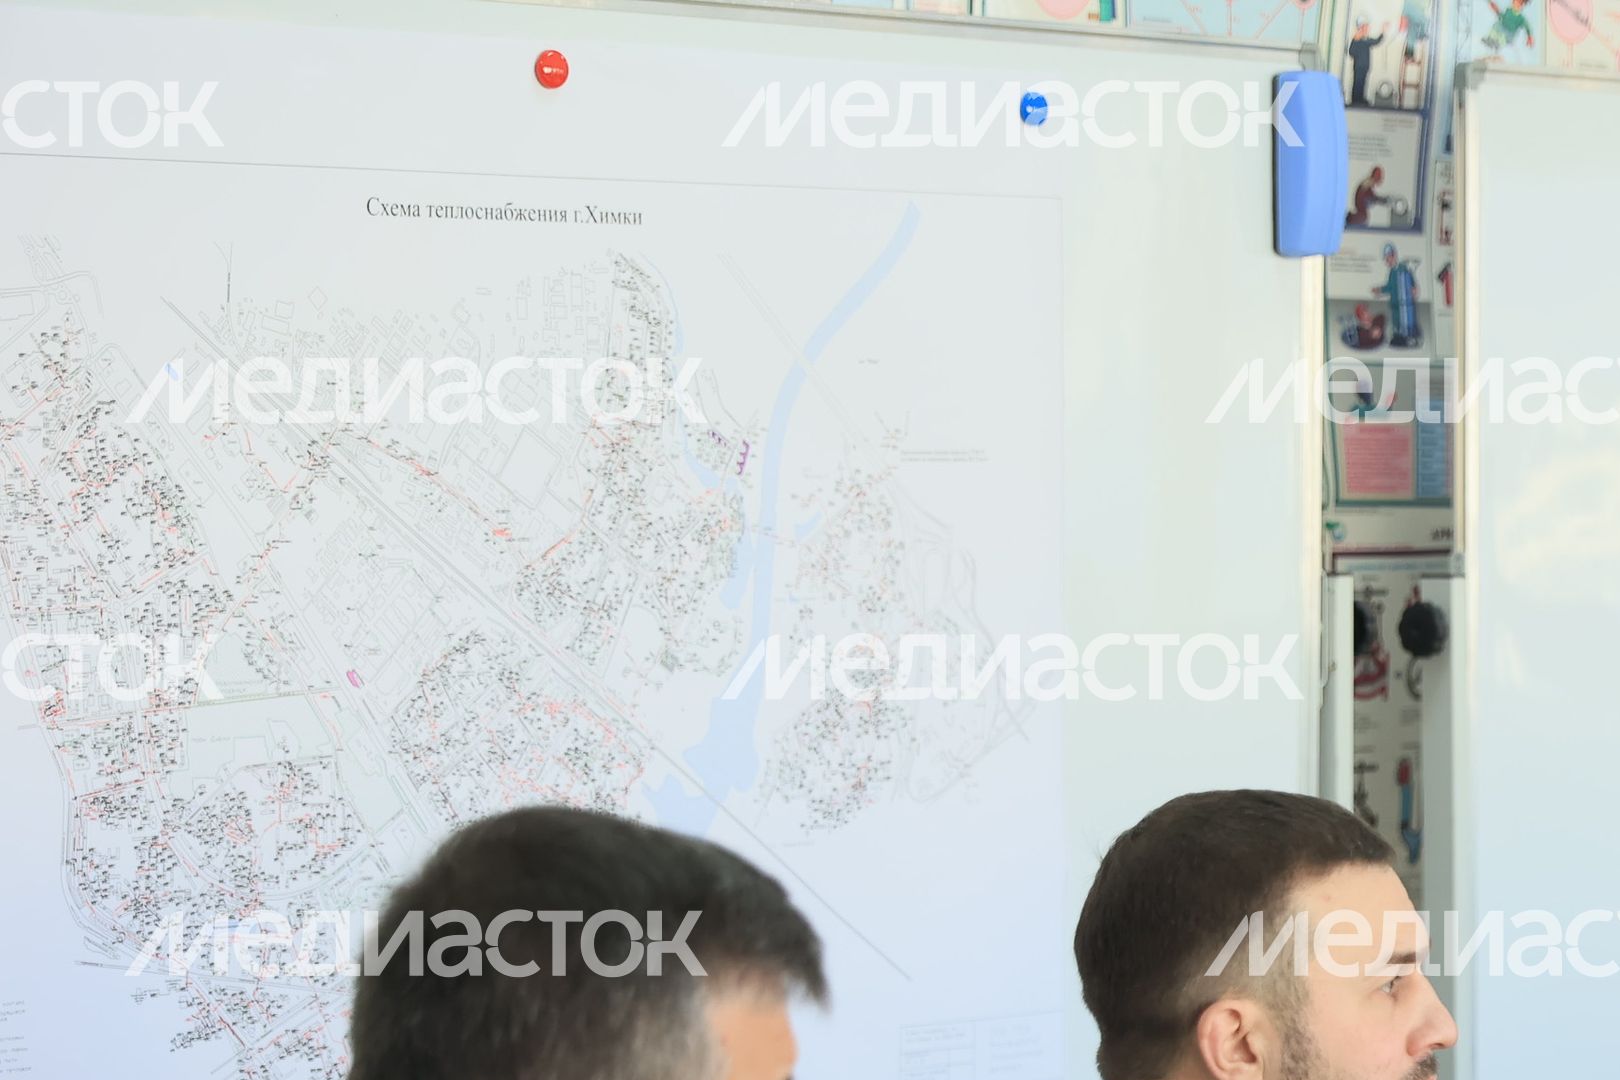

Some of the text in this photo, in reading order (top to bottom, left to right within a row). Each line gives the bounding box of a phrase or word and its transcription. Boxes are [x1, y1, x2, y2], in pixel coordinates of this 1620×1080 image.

[366, 196, 643, 226] Схема теплоснабжения г.Химки
